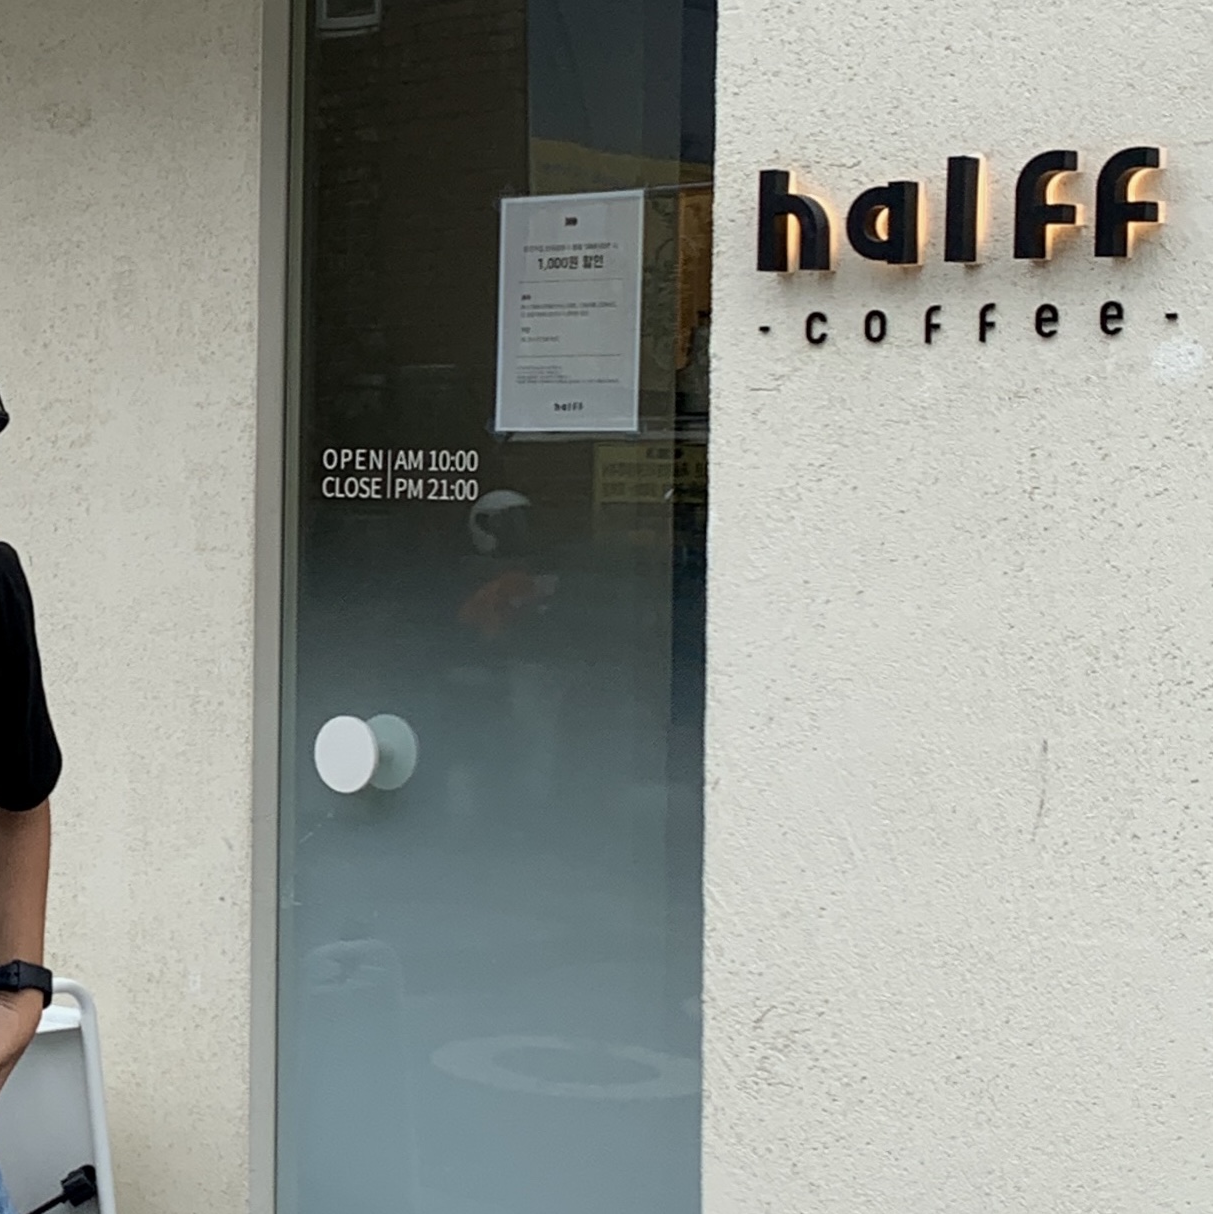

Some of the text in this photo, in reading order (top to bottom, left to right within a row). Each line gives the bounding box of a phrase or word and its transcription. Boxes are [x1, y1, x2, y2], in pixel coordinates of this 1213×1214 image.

[756, 146, 1162, 272] halff
[322, 449, 479, 472] OPEN AM 10:00
[322, 476, 479, 501] CLOSE PM 21:00
